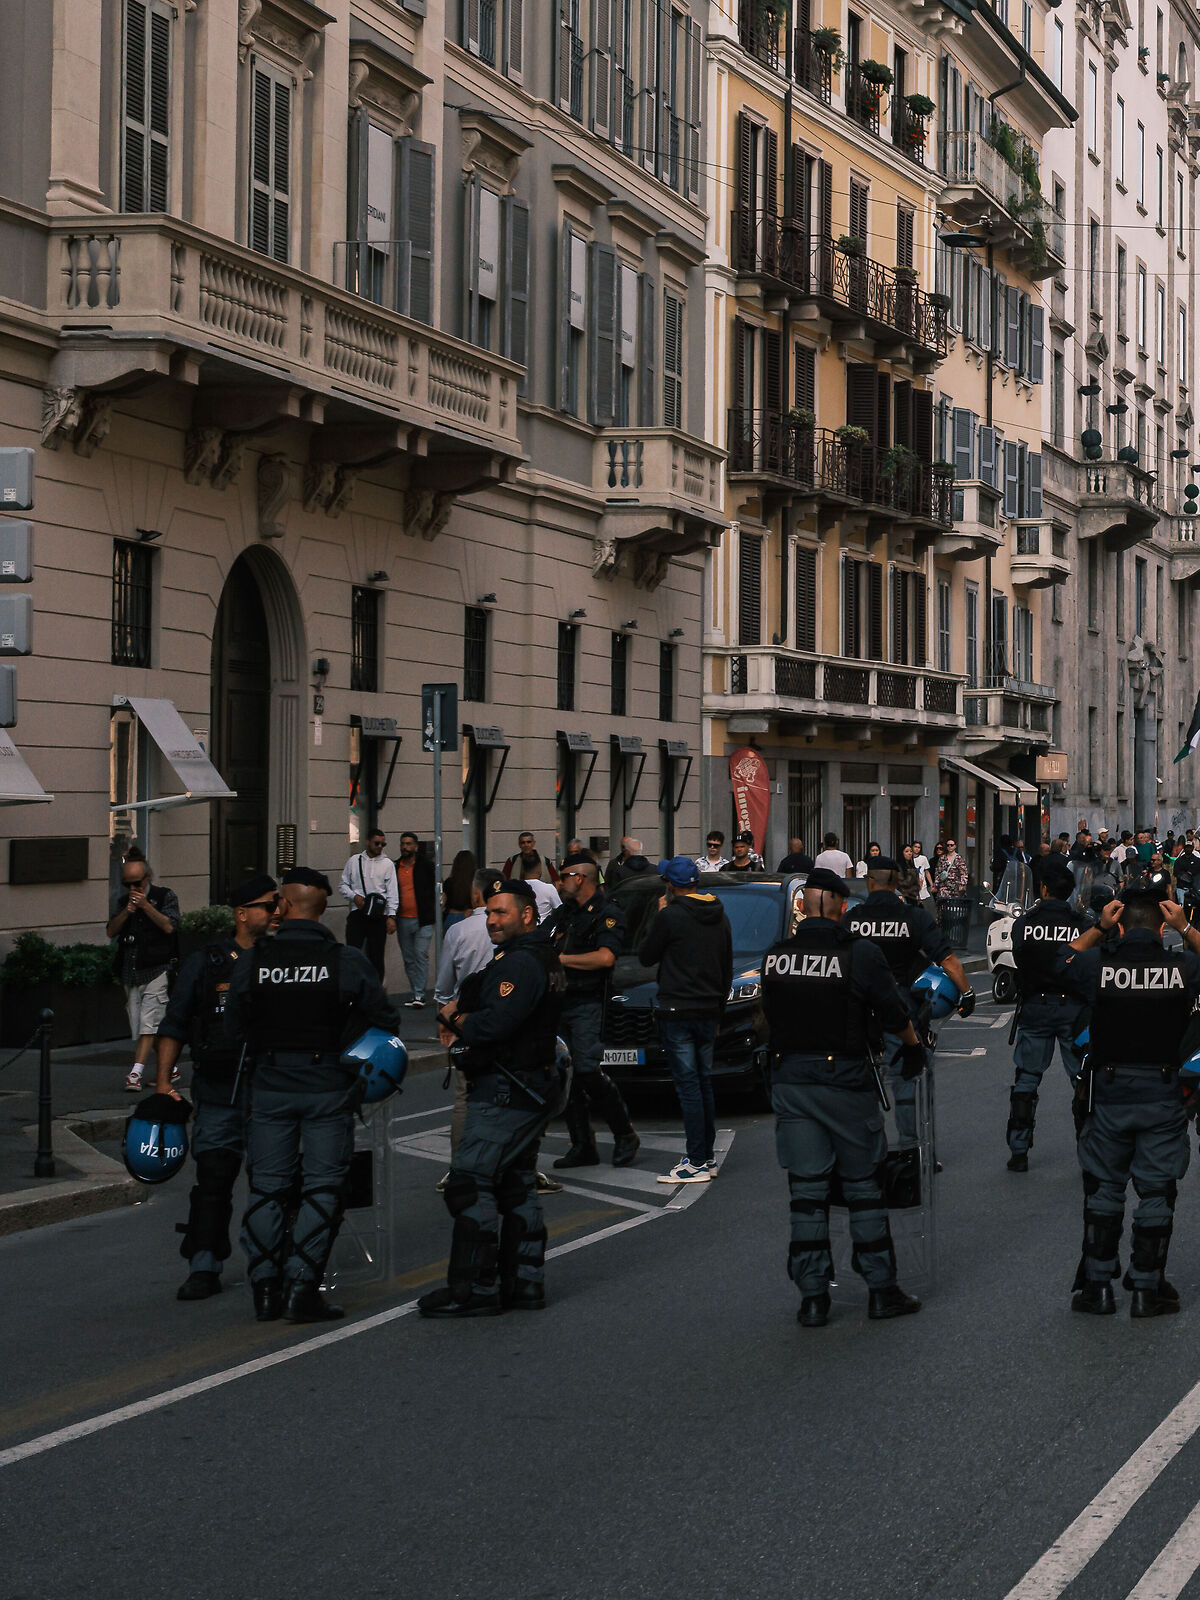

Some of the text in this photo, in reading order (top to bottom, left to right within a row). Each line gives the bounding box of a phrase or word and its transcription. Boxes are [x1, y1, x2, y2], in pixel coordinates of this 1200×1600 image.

[850, 920, 910, 938] POLIZIA
[1023, 925, 1080, 942] POLIZIA
[258, 966, 330, 984] POLIZIA
[764, 954, 843, 978] POLIZIA
[1100, 966, 1184, 989] POLIZIA
[140, 1142, 184, 1158] POLZIA
